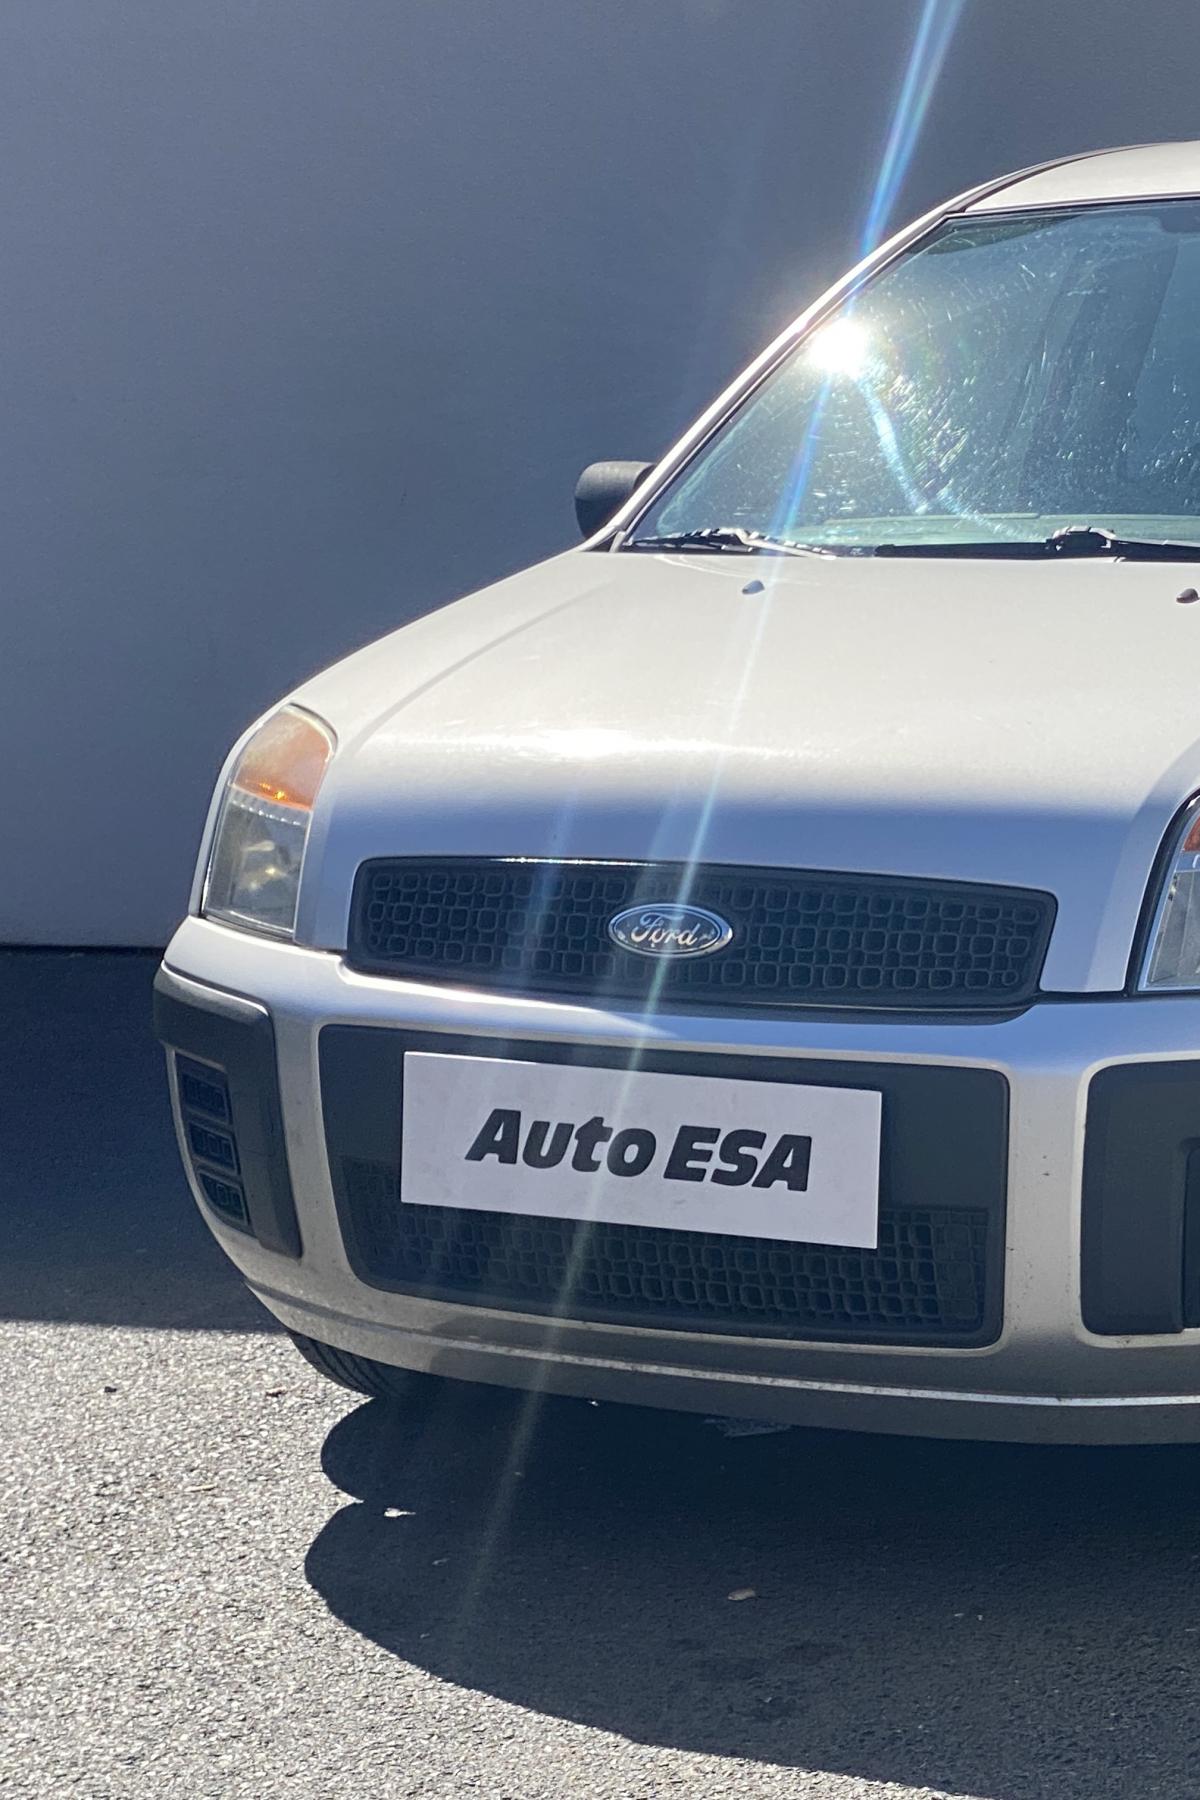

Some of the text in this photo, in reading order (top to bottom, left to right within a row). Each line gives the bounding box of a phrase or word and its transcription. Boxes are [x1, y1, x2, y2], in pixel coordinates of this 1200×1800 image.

[630, 911, 704, 946] Ford
[465, 1109, 812, 1192] Auto ESA
